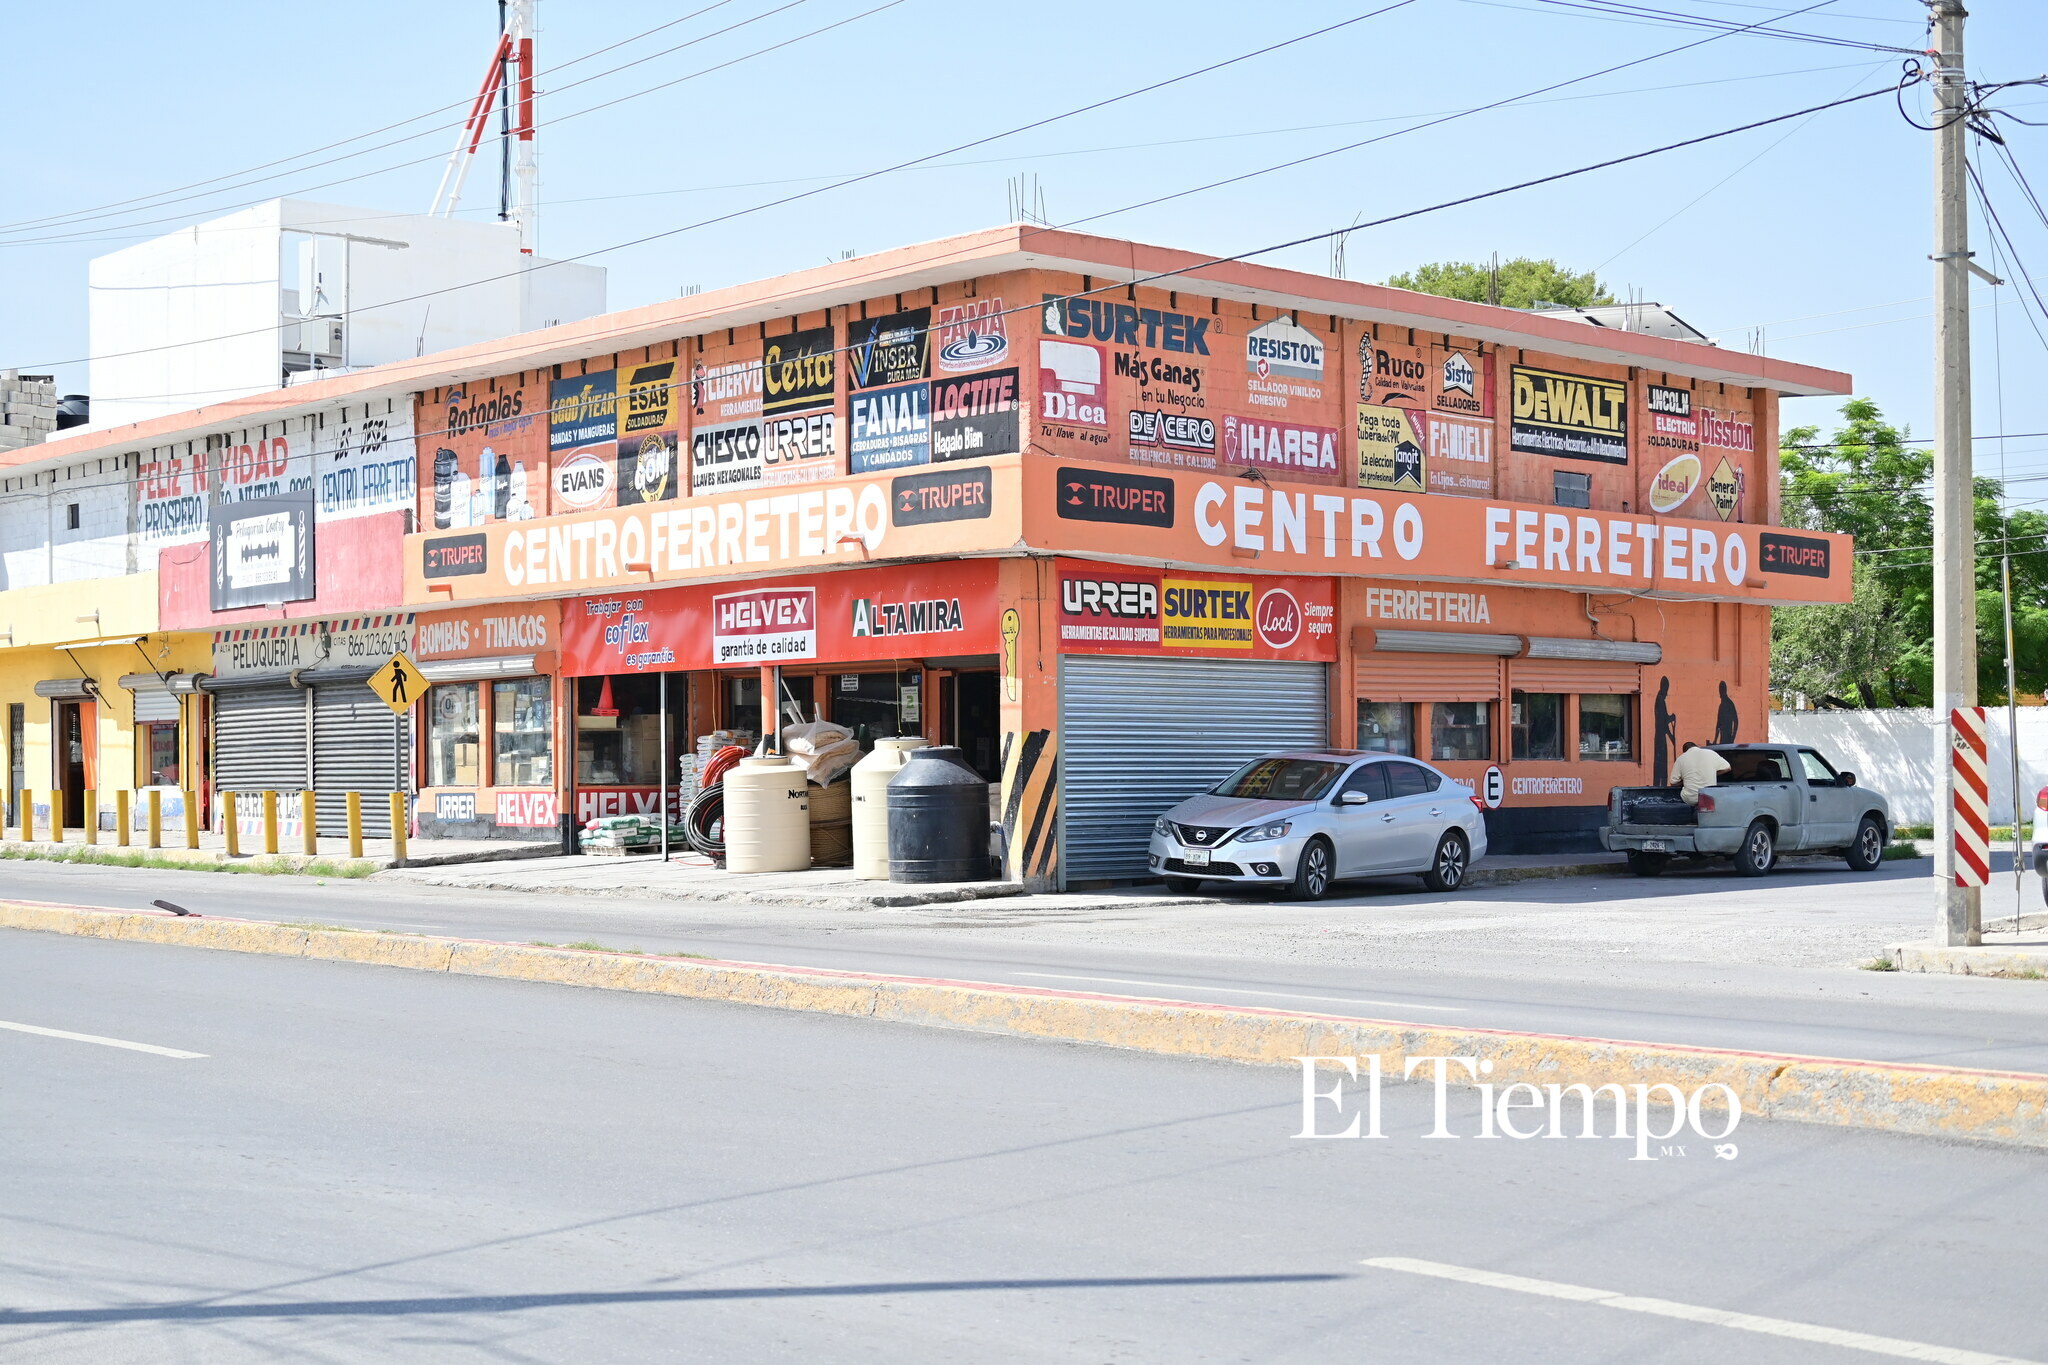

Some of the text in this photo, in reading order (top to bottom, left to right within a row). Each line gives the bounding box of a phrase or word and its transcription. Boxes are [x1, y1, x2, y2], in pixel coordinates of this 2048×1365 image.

[938, 297, 1008, 347] FAMA
[1068, 298, 1211, 355] SURTEK
[1248, 336, 1320, 365] RESISTOL
[707, 360, 763, 402] CUERVO
[887, 367, 920, 383] DURA MAS
[1114, 352, 1200, 393] Más Ganas
[629, 383, 669, 411] ESAB
[933, 375, 1014, 422] LOCTITE
[1142, 388, 1205, 414] en tu Negocio
[1247, 380, 1289, 395] SELLADOR
[1248, 393, 1288, 407] ADHESIVO
[1647, 387, 1690, 415] LINCOLN
[447, 385, 523, 440] Rotoplas
[853, 390, 927, 438] FANAL
[1043, 391, 1106, 425] Dica
[1436, 395, 1481, 412] SELLADORES
[550, 423, 615, 446] BANDAS Y MANGUERAS
[627, 413, 664, 429] SOLDADURAS
[1359, 412, 1401, 430] Pega toda
[1656, 416, 1697, 436] ELECTRIC
[1700, 407, 1754, 453] Disston
[692, 425, 761, 467] CHESCO
[763, 412, 836, 464] URREA
[893, 432, 928, 446] BISAGRAS
[934, 426, 983, 457] Hagalo Bien
[1041, 425, 1108, 446] Tu llave al agua
[1430, 421, 1490, 463] FANDELI
[137, 458, 183, 501] FELIZ
[192, 437, 289, 494] NVIDAD
[862, 450, 913, 467] Y CANDADOS
[1174, 454, 1184, 466] EN
[1186, 455, 1217, 469] CALIDAD
[1361, 451, 1368, 466] La
[1394, 447, 1419, 470] Tangit
[322, 467, 358, 513] CENTRO
[562, 467, 605, 493] EVANS
[693, 471, 715, 488] LLAVES
[717, 465, 762, 484] HEXAGONALES
[1658, 473, 1689, 494] ideal
[1710, 477, 1737, 494] General
[919, 482, 984, 511] TRUPER
[1090, 483, 1166, 514] TRUPER
[1715, 495, 1733, 510] Paint
[144, 495, 203, 541] PROSPERO
[503, 484, 887, 586] CENTRO FERRETERO
[1194, 481, 1747, 587] CENTRO FERRETERO
[440, 544, 483, 567] TRUPER
[1779, 545, 1825, 568] TRUPER
[585, 597, 643, 619] Trabajar con
[1062, 579, 1158, 619] URREA
[1164, 587, 1251, 620] SURTEK
[1304, 602, 1334, 622] Siempre
[1366, 587, 1491, 624] FERRETERIA
[721, 597, 808, 630] HELVEX
[852, 598, 964, 637] ALTAMIRA
[1262, 601, 1294, 632] Lock
[419, 615, 547, 656] BOMBAS TINACOS
[605, 613, 649, 654] coflex
[1061, 625, 1102, 640] HERRAMIENTAS
[1109, 626, 1134, 642] CALIDAD
[1134, 627, 1160, 642] SUPERIOR
[1163, 625, 1252, 642] HERRAMIENTAS PARA PROFESIONALES
[1308, 622, 1333, 640] seguro
[233, 638, 300, 669] PELUQUERIA
[626, 653, 637, 666] es
[721, 633, 806, 661] garantía de calidad
[1487, 772, 1499, 800] E
[1511, 777, 1583, 795] CENTROFERRETERO
[436, 793, 475, 820] URREA
[496, 793, 556, 825] HELVEX
